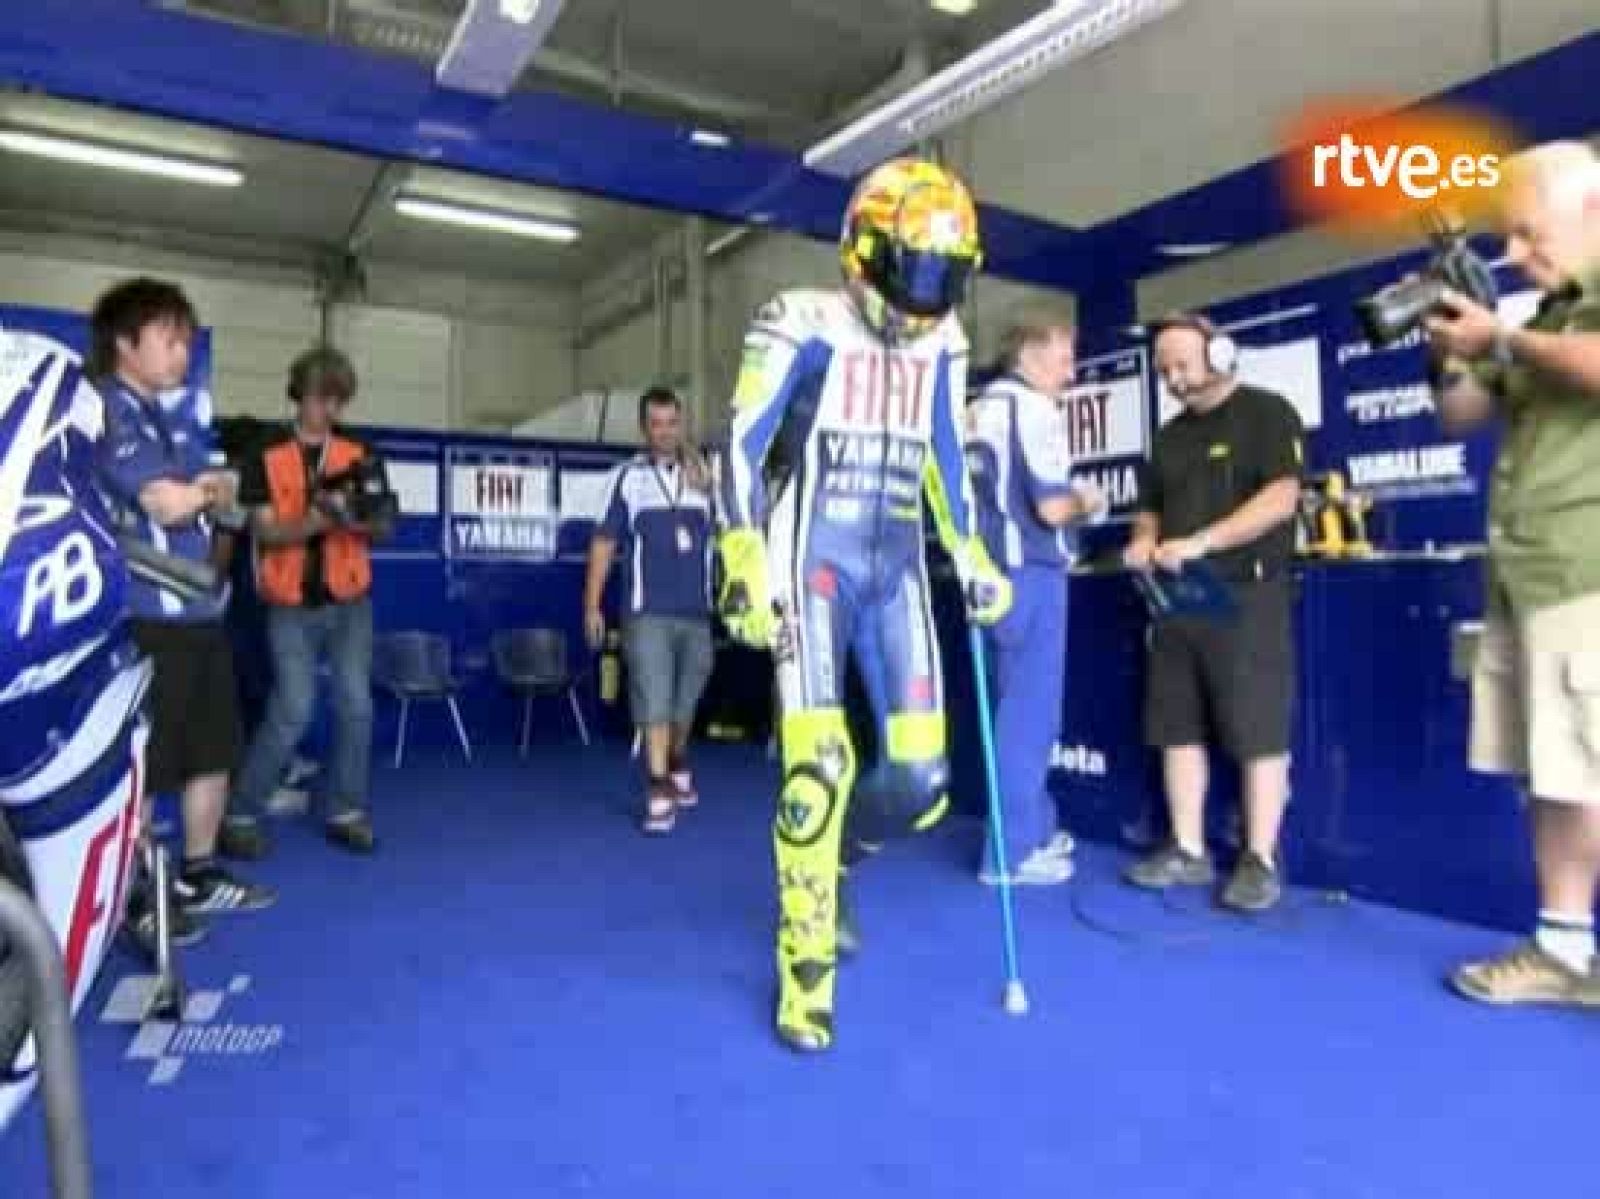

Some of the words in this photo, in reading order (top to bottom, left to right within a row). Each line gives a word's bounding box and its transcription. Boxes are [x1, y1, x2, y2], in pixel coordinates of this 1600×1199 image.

[841, 350, 931, 429] FIAT
[1056, 390, 1112, 455] IAT
[476, 469, 524, 511] FIAT
